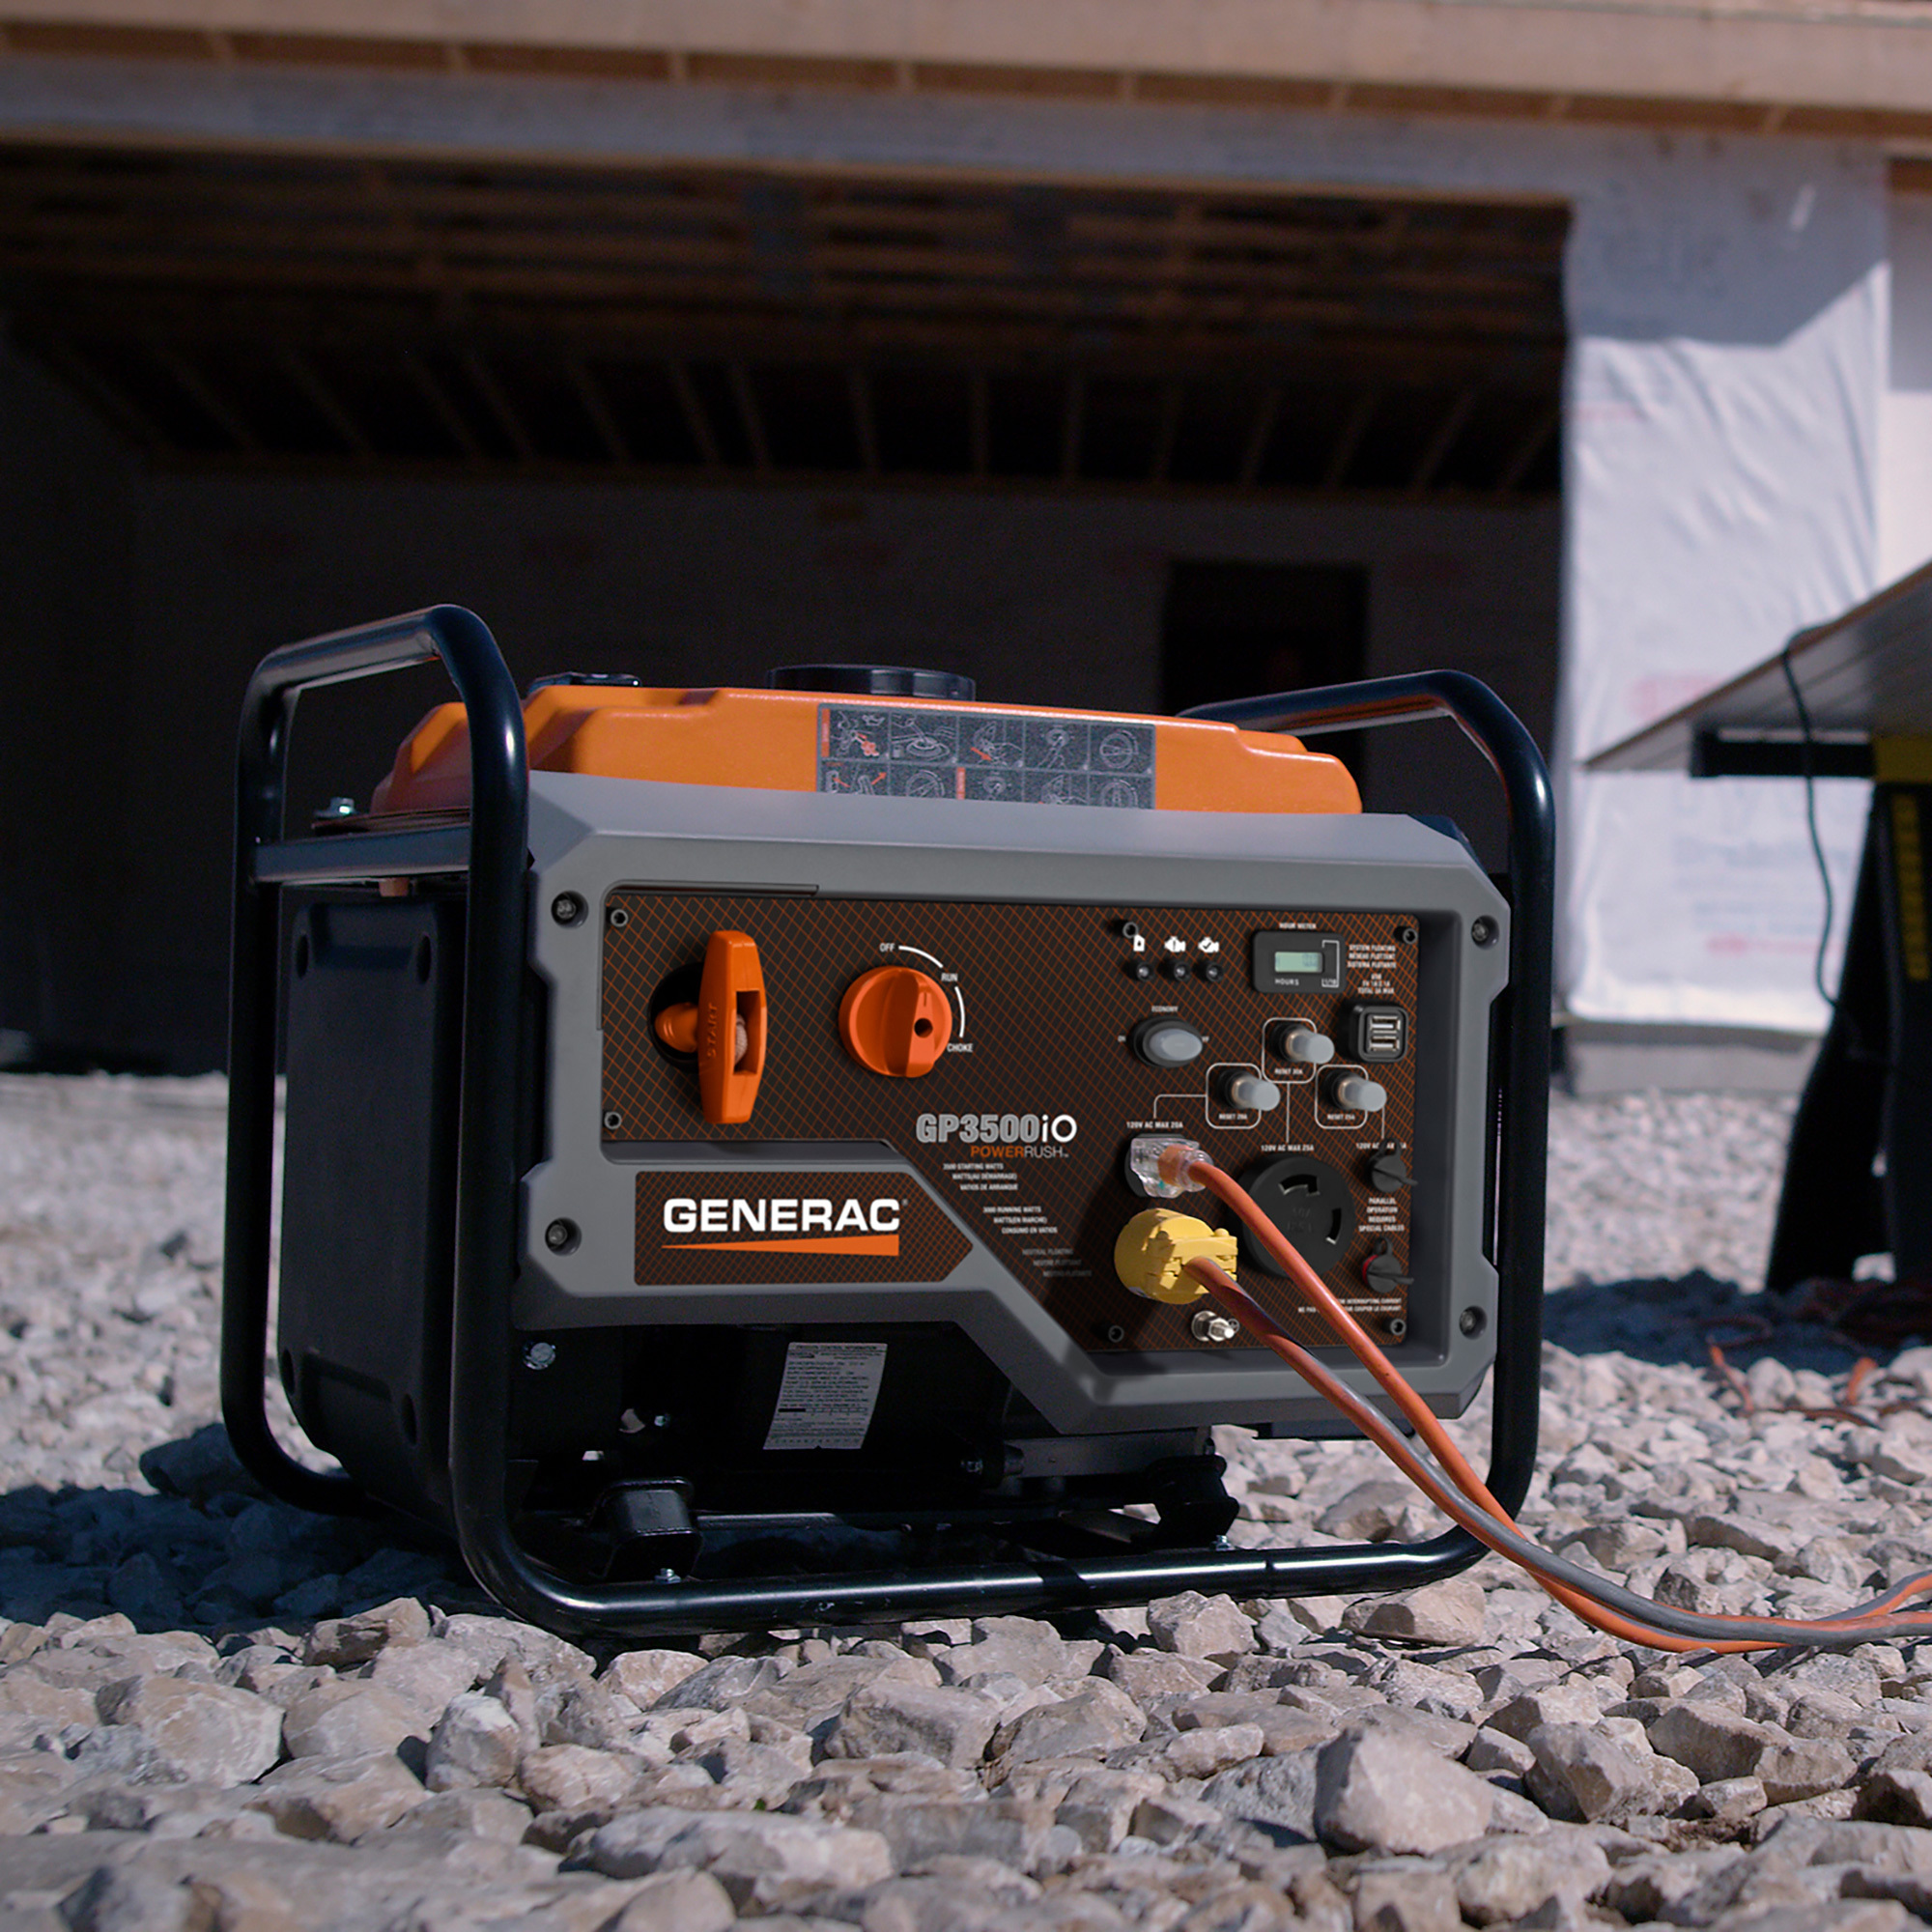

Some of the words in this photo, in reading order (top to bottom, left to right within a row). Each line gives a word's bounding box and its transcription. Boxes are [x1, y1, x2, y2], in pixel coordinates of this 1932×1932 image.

[879, 943, 895, 952] OFF
[941, 973, 958, 981] RUN
[706, 1002, 718, 1059] START
[947, 1043, 973, 1052] CHOKE
[664, 1198, 900, 1233] GENERAC
